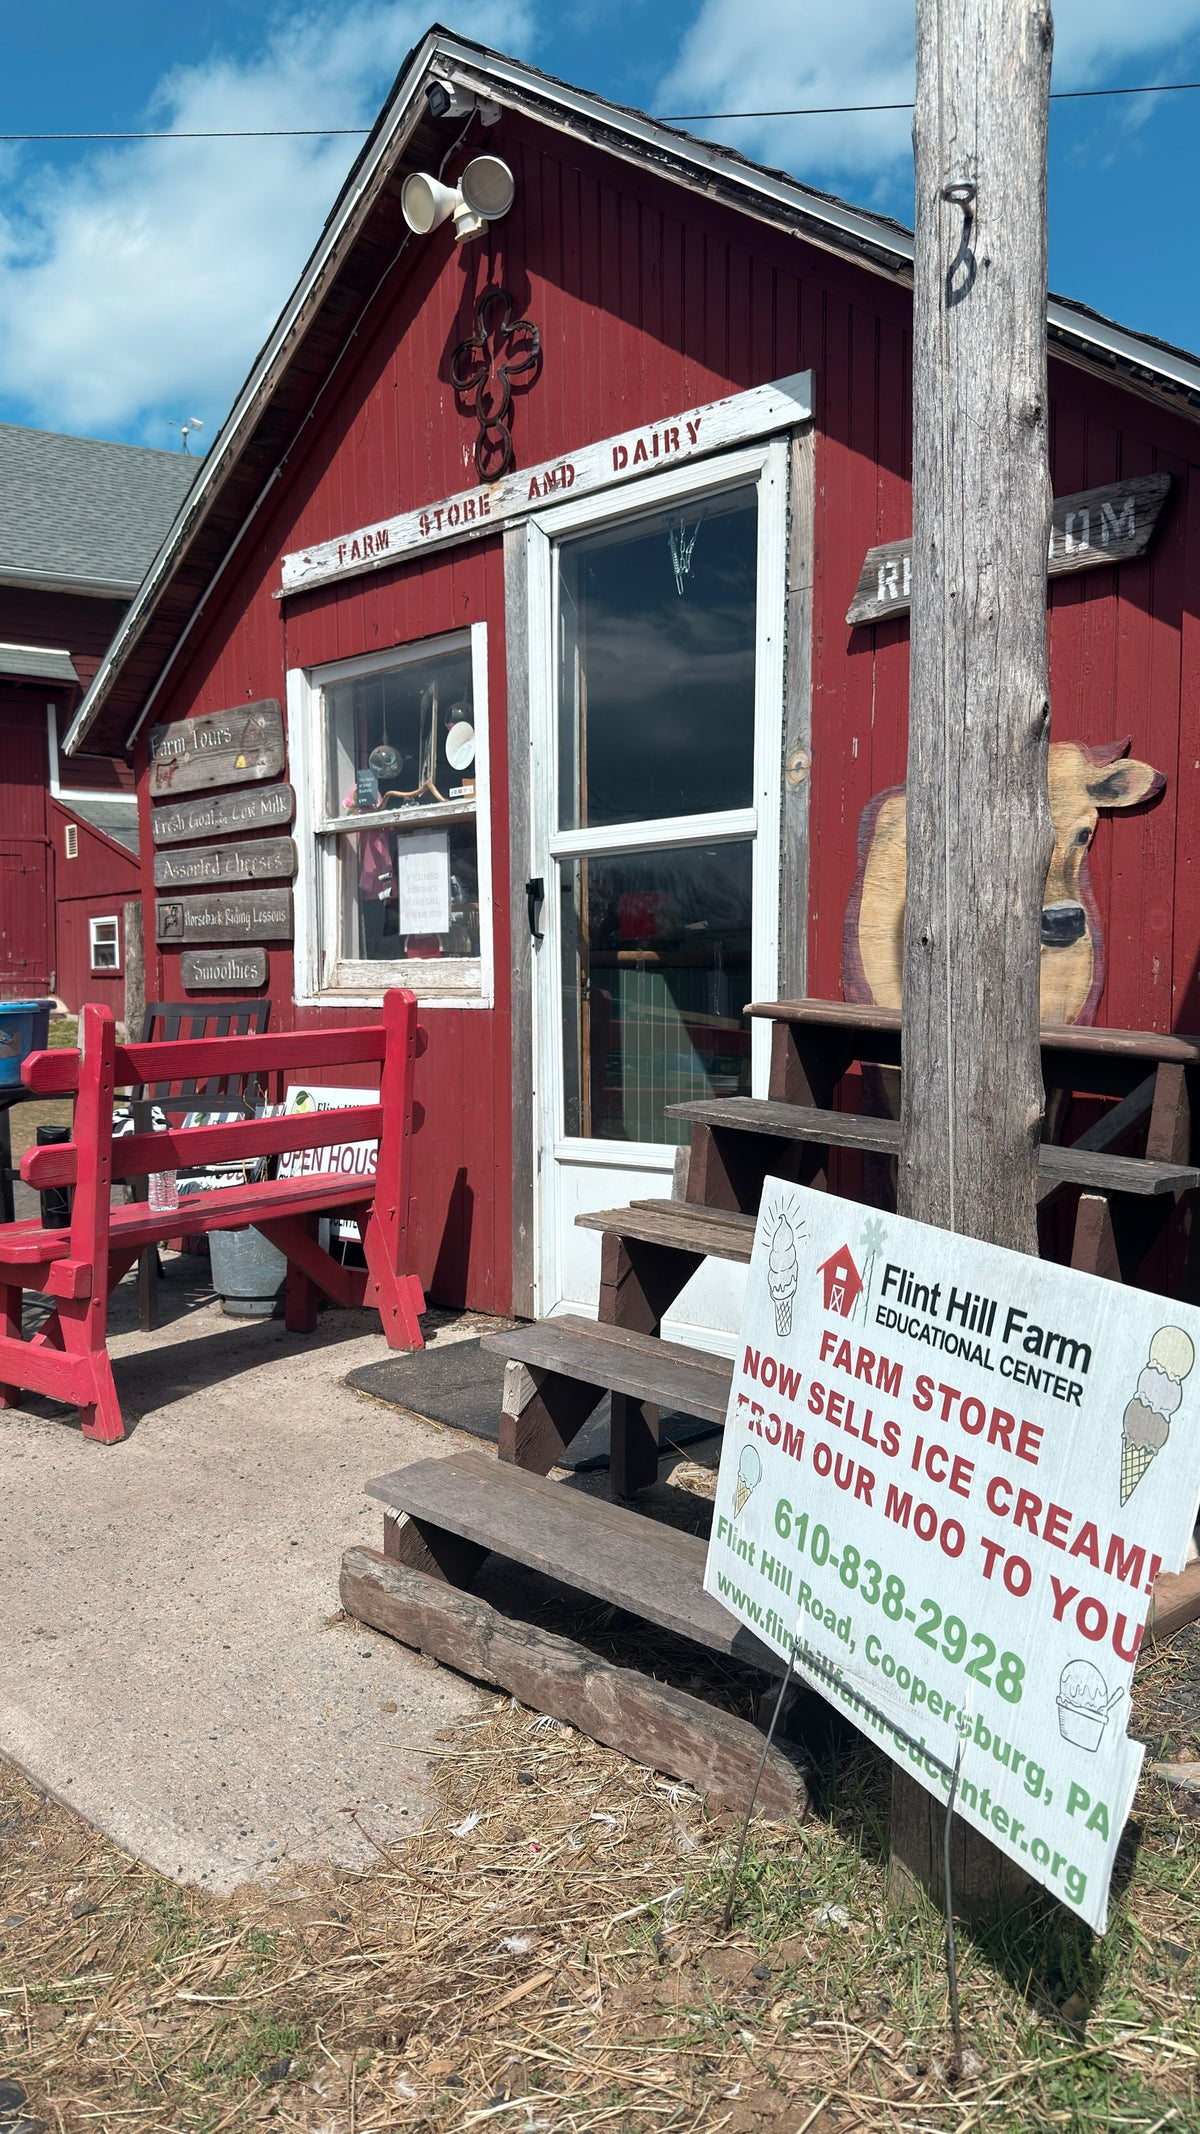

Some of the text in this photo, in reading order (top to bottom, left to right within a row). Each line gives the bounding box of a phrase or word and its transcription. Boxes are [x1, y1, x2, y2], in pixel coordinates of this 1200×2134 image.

[338, 418, 702, 565] FARM STORE AND DAIRY
[152, 727, 232, 758] Farm Tours
[261, 794, 287, 816] Milk
[163, 853, 282, 879] Assorted Cheeses
[185, 908, 286, 932] Horseback Riding Lessons
[193, 959, 258, 982] Smoothies
[328, 1145, 378, 1175] HOUS
[876, 1306, 1084, 1407] EDUCATIONAL CENTER
[881, 1264, 1093, 1374] Flint Hill Farm
[820, 1330, 1044, 1465] FARM STORE
[742, 1345, 1162, 1596] NOW SELLS ICE CREAM!
[774, 1498, 1026, 1704] 610-838-2928
[813, 1442, 876, 1507] OUR
[884, 1484, 966, 1558] MOO
[980, 1537, 1032, 1598] TO
[1050, 1575, 1144, 1663] YOU
[716, 1514, 1110, 1842] Flint Hill Road, Coopersburg, PA
[717, 1571, 1089, 1906] www.flinhillfarm-edcenter.org
